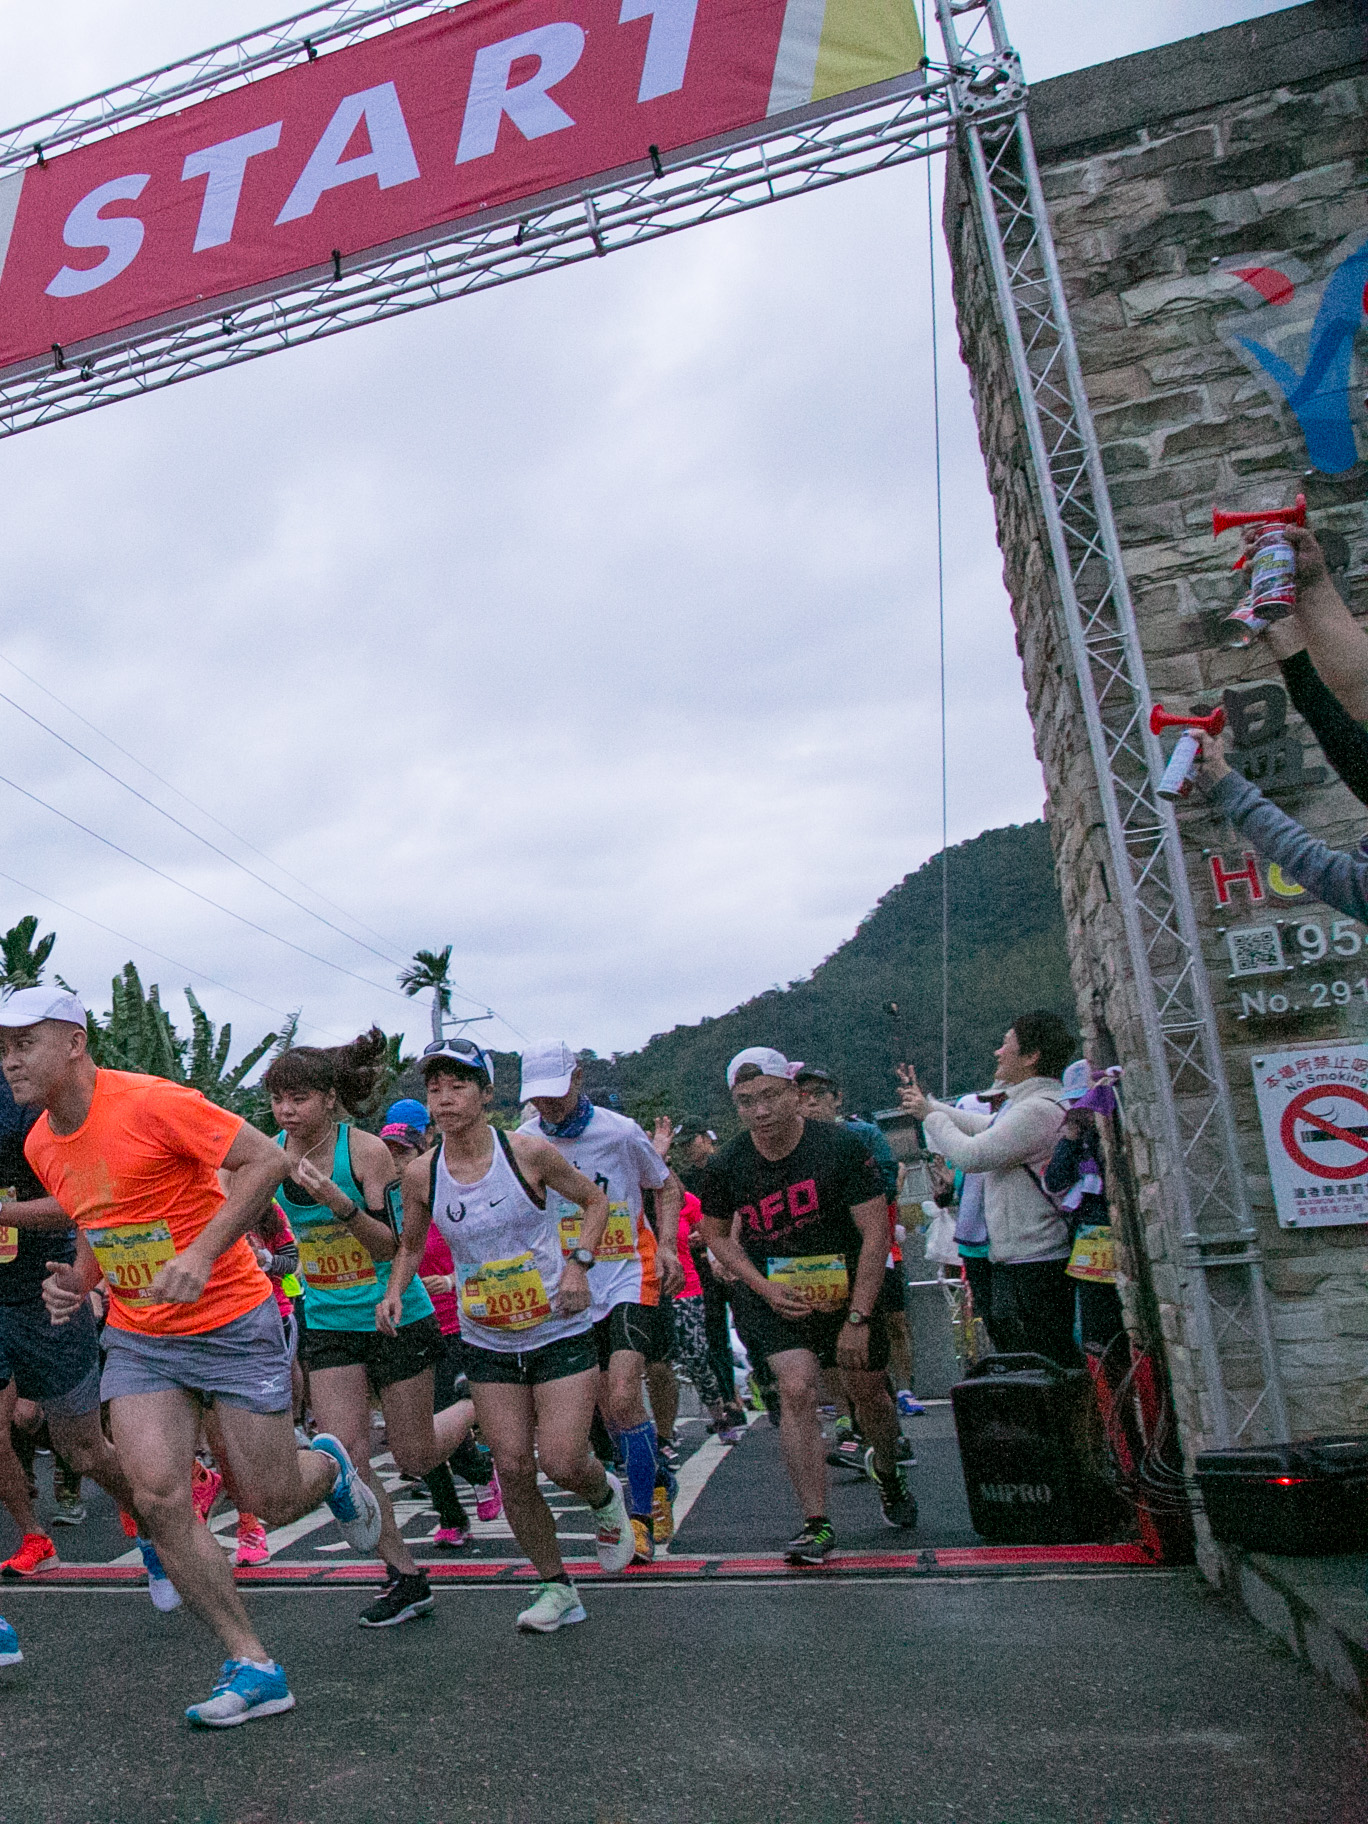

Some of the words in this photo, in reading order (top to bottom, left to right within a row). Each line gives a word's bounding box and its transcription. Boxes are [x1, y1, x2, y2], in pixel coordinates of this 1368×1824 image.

[44, 0, 697, 297] START
[1297, 919, 1368, 960] 95
[1241, 991, 1300, 1015] No.
[1285, 1080, 1305, 1093] No
[1306, 1071, 1368, 1088] Smoking
[317, 1251, 362, 1274] 2019
[486, 1288, 539, 1314] 2032
